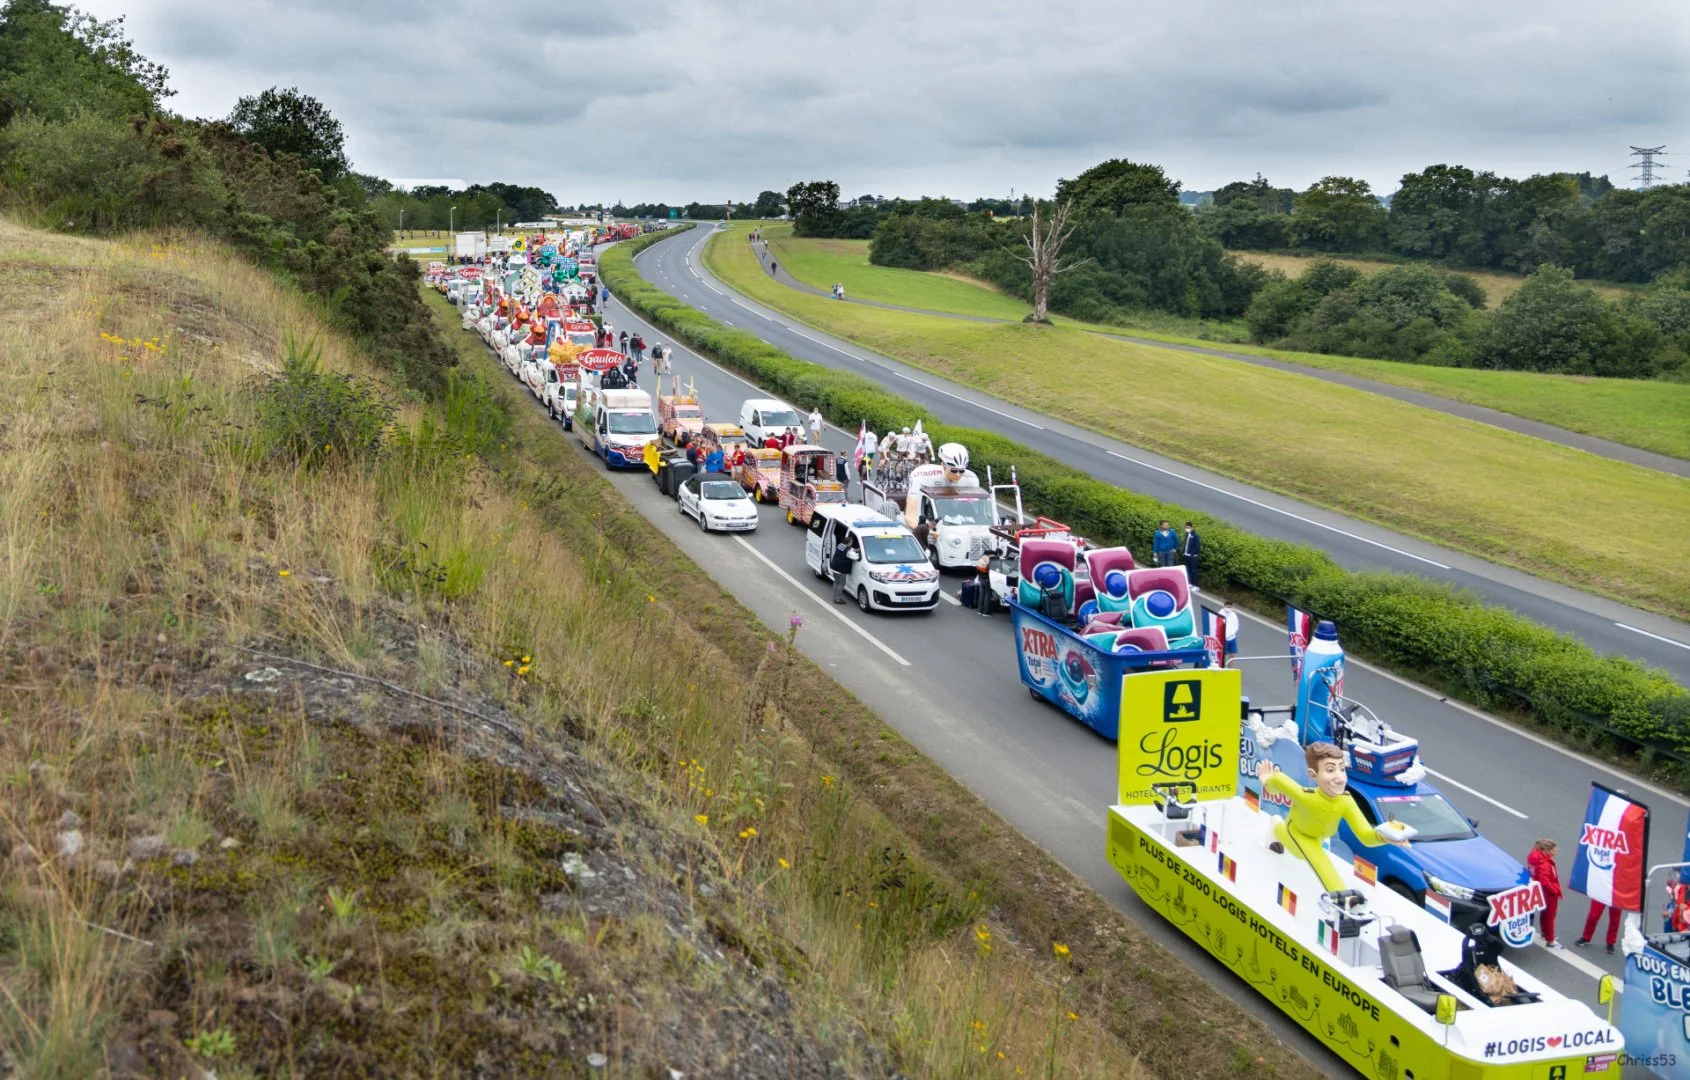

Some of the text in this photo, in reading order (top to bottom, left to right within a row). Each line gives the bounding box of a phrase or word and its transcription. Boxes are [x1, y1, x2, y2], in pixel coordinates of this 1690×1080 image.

[584, 352, 623, 366] Gaulois
[1136, 727, 1223, 780] Logis
[1172, 784, 1231, 796] ESTURANTS
[1139, 837, 1380, 1021] PLUS DE 2300 LOGIS HOTELS EN EUROPE
[1508, 916, 1529, 930] Total
[1634, 954, 1667, 977] TOUS
[1651, 975, 1690, 1013] BLE
